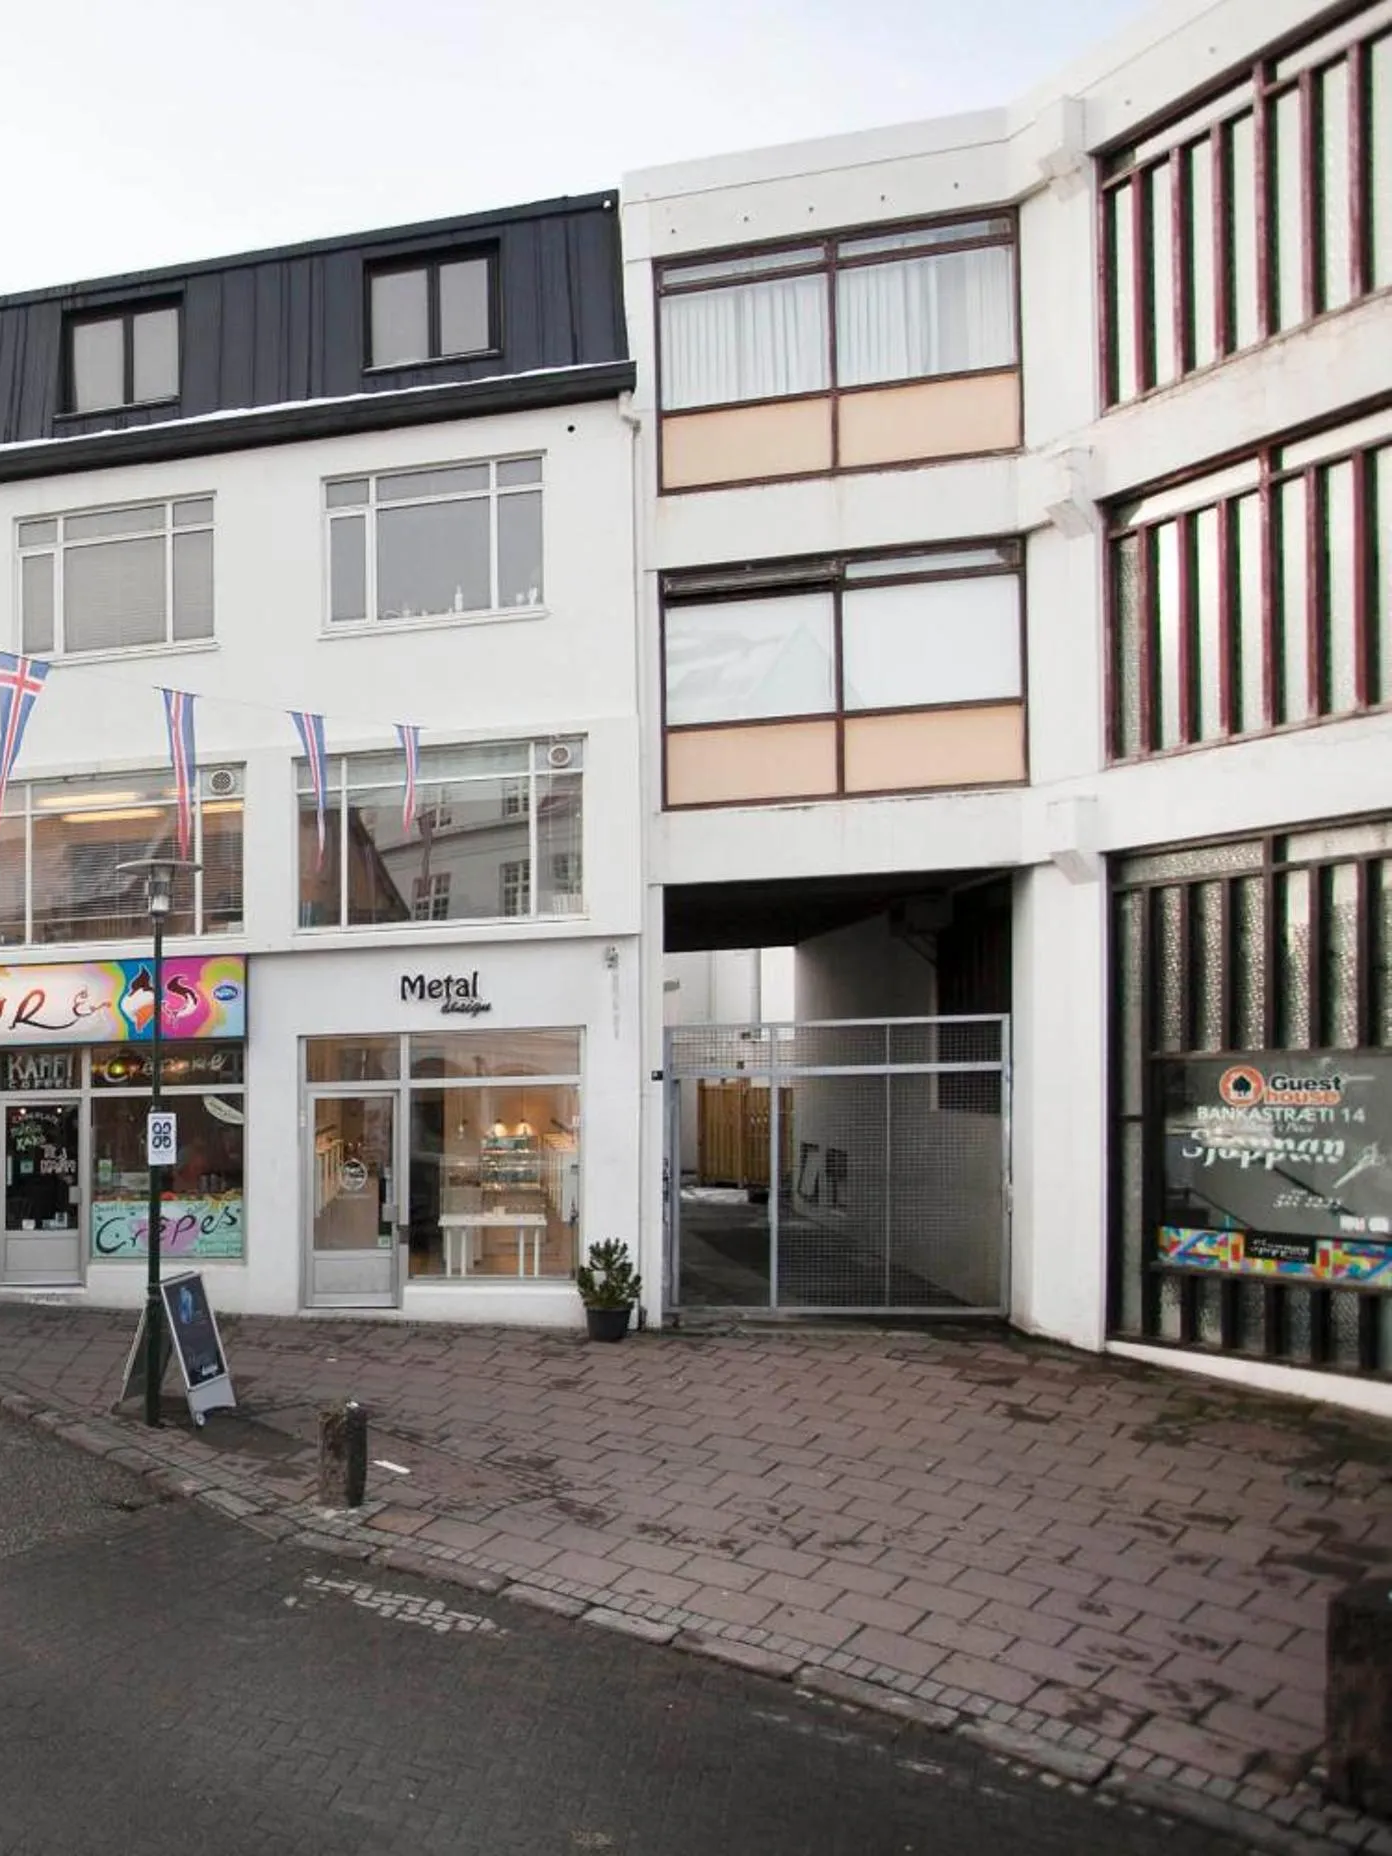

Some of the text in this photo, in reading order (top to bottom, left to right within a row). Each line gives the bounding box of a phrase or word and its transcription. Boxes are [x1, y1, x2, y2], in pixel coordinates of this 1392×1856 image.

[401, 971, 478, 1000] Metal
[440, 1000, 492, 1017] design
[1269, 1073, 1342, 1092] Guest
[1265, 1090, 1342, 1105] house
[1196, 1105, 1365, 1124] BANKASTRÆTI 14
